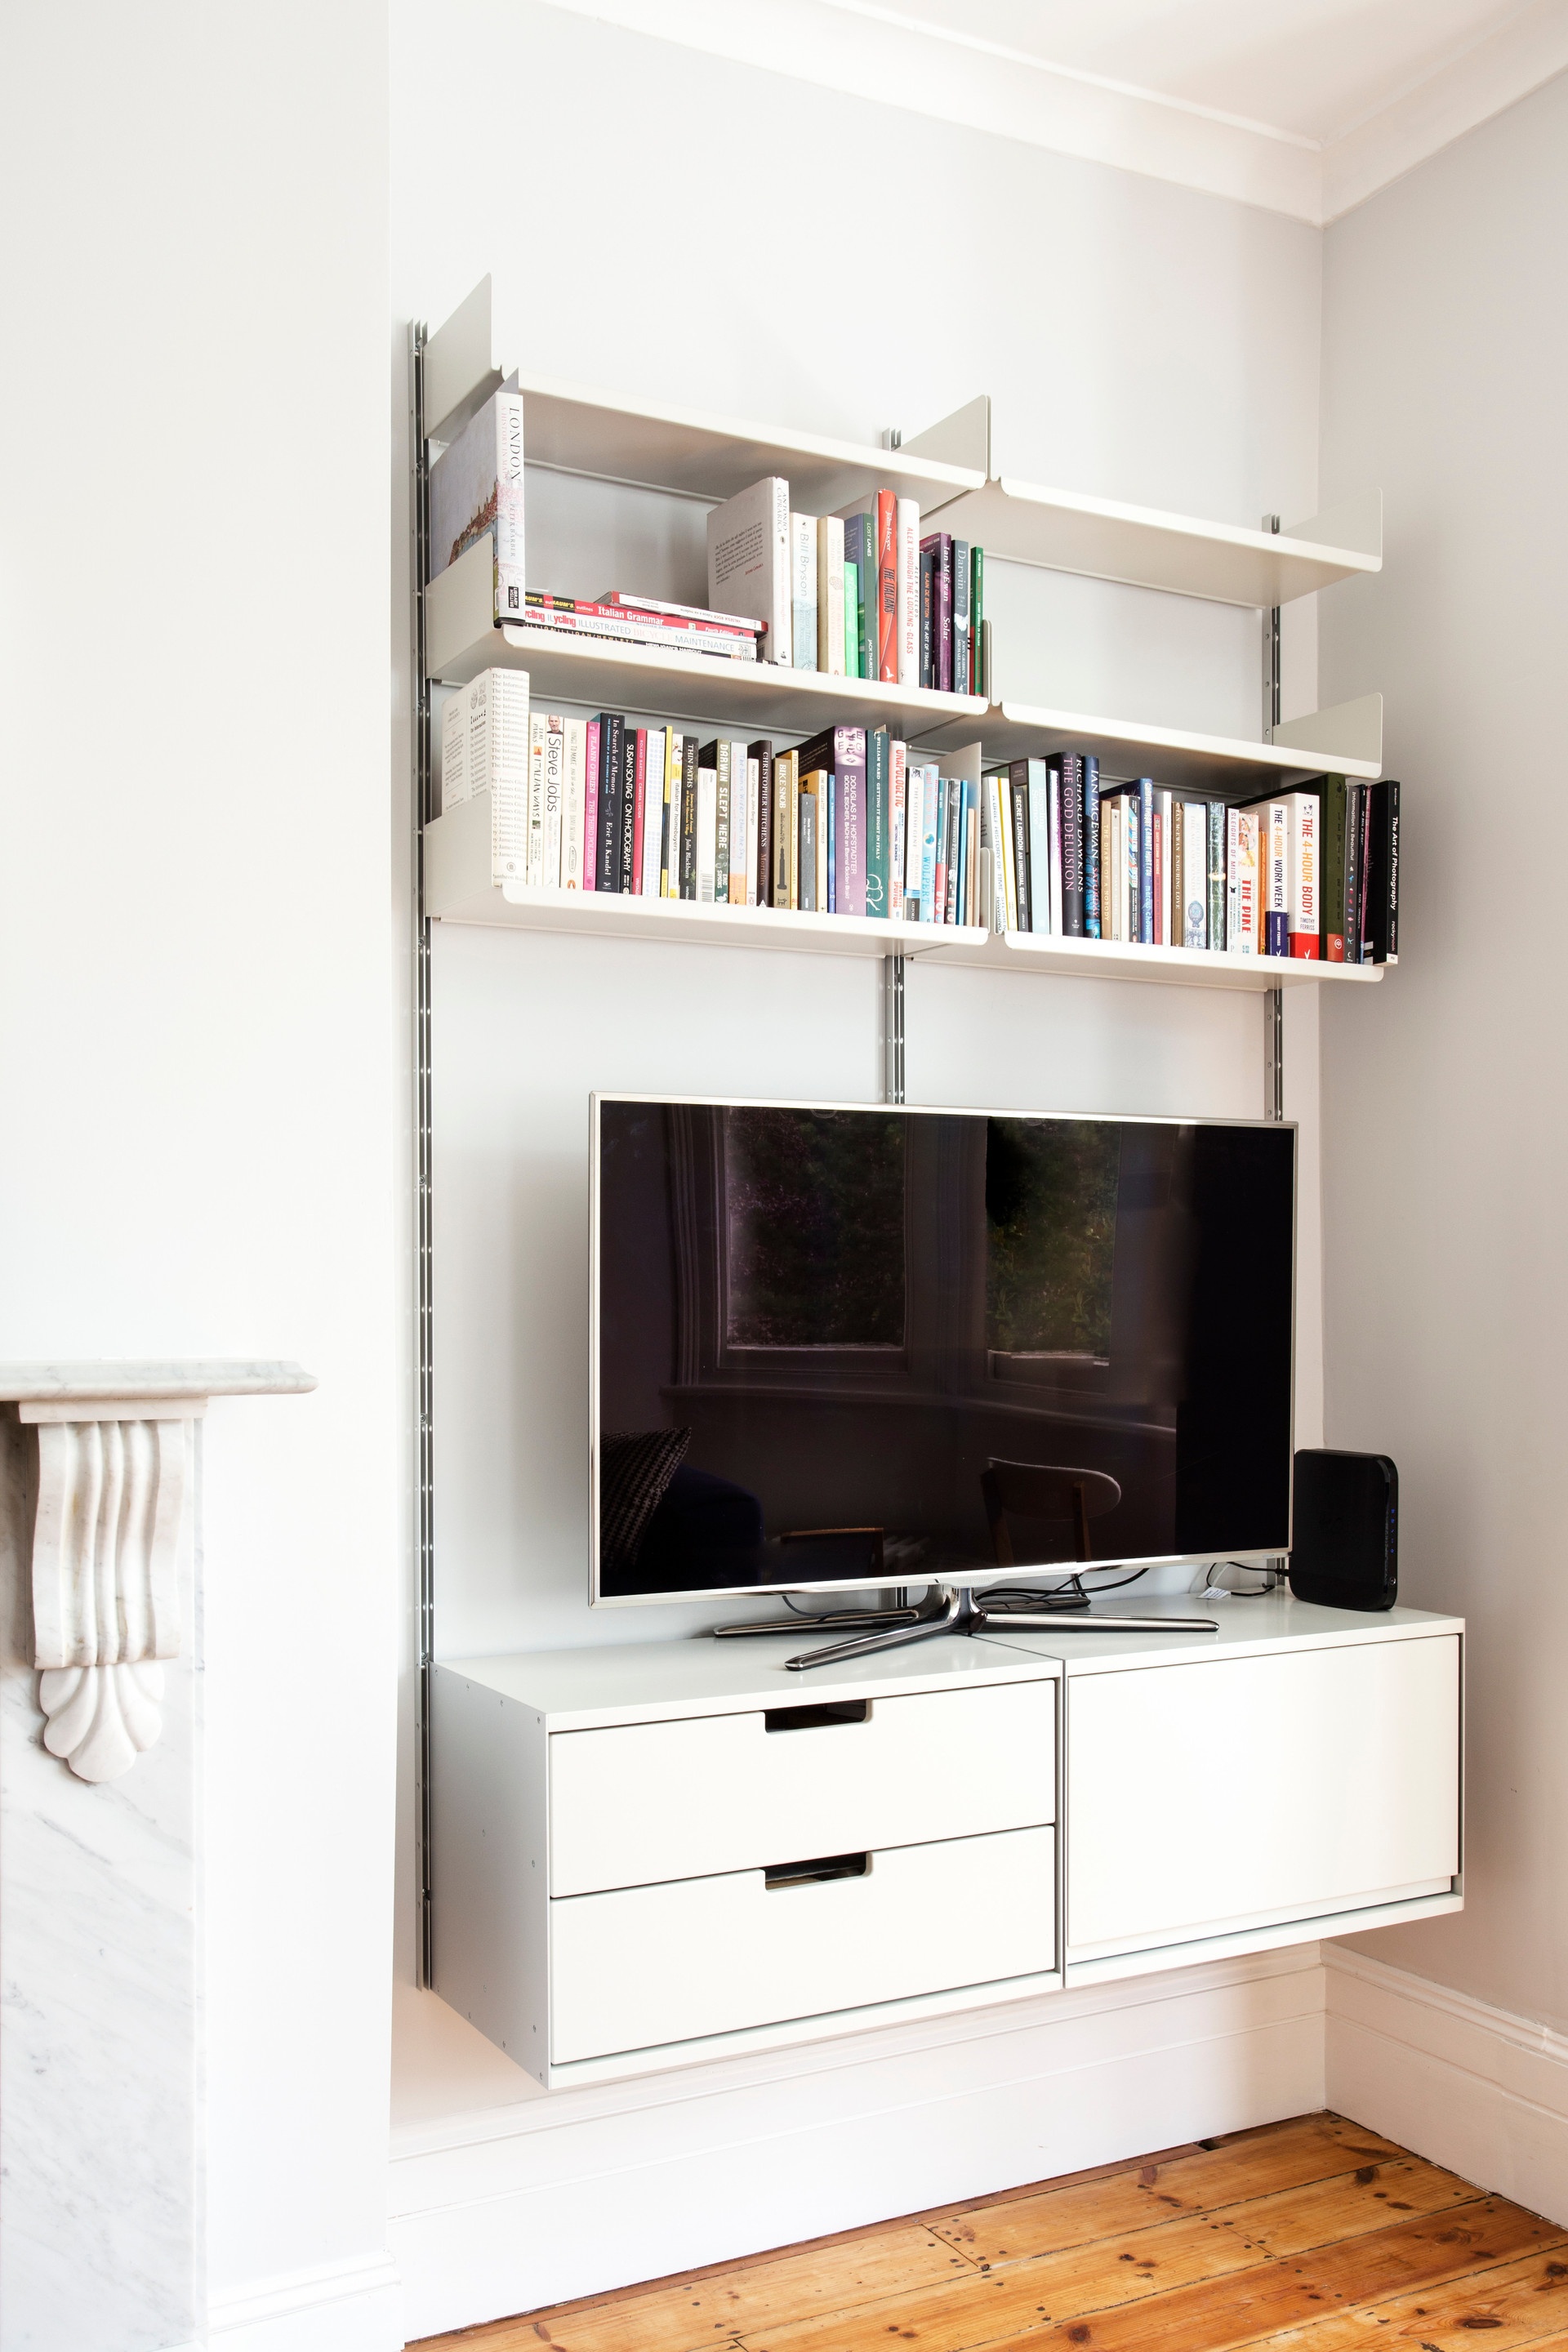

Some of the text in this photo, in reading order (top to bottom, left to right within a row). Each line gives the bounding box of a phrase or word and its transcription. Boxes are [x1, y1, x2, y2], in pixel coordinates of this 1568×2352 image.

[509, 408, 522, 482] LONDON
[799, 533, 809, 597] Bill Bryson
[957, 550, 966, 590] Darwin
[884, 568, 895, 615] THE ITALIANS
[924, 589, 930, 597] DE
[598, 606, 664, 626] Italian Grammar
[924, 643, 929, 651] OF
[612, 719, 619, 728] In
[547, 737, 561, 776] Steve
[612, 755, 618, 764] of
[778, 764, 786, 786] BIKE
[532, 758, 541, 817] ITALIAN WAYS
[547, 777, 560, 812] Jobs
[719, 744, 728, 849] DARWIN SLEPT HERE
[895, 749, 905, 808] UNAPOLOGETIC
[625, 804, 632, 817] ON
[759, 751, 770, 887] CHRISTOPHER HITCHENS Mortality
[850, 814, 857, 822] R.
[1064, 757, 1075, 892] THE GOD DELUSION
[586, 836, 595, 877] POLICEMAN
[624, 817, 632, 871] PHOTOGRAPHY
[737, 848, 745, 860] Sky
[1018, 851, 1023, 861] AN
[1231, 849, 1236, 858] OF
[1274, 809, 1283, 909] THE 4-HOUR WORK WEEK
[1392, 847, 1398, 858] of
[923, 856, 931, 905] WOLPERT
[996, 861, 1002, 873] OF
[1104, 868, 1110, 880] OF
[1104, 880, 1110, 889] A
[1302, 818, 1313, 917] THE 4-HOUR BODY
[1390, 858, 1398, 911] Photography
[1241, 879, 1252, 934] THE PIKE
[1300, 923, 1315, 931] FERRISS
